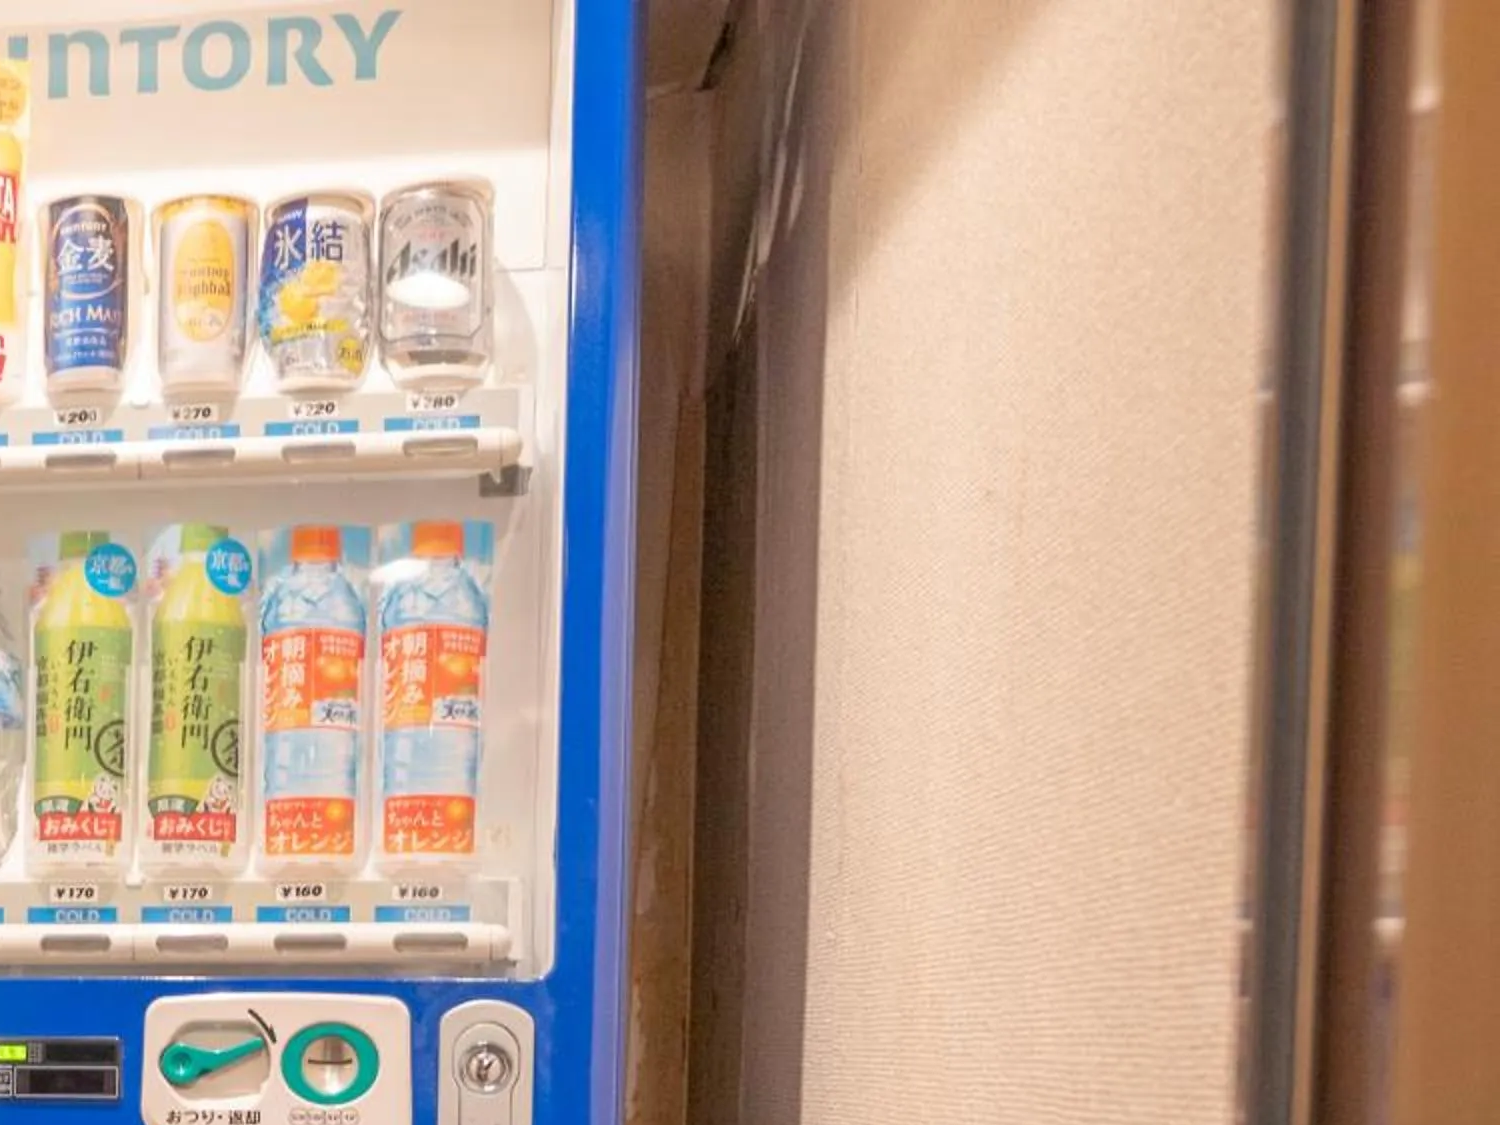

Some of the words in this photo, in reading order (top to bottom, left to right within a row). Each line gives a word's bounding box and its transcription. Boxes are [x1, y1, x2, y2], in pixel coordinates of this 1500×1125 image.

[274, 220, 347, 270] 氷結
[58, 235, 115, 275] 金麦
[55, 909, 100, 924] COLD
[169, 909, 215, 924] COLD
[285, 908, 331, 923] COLD
[404, 908, 450, 923] COLD
